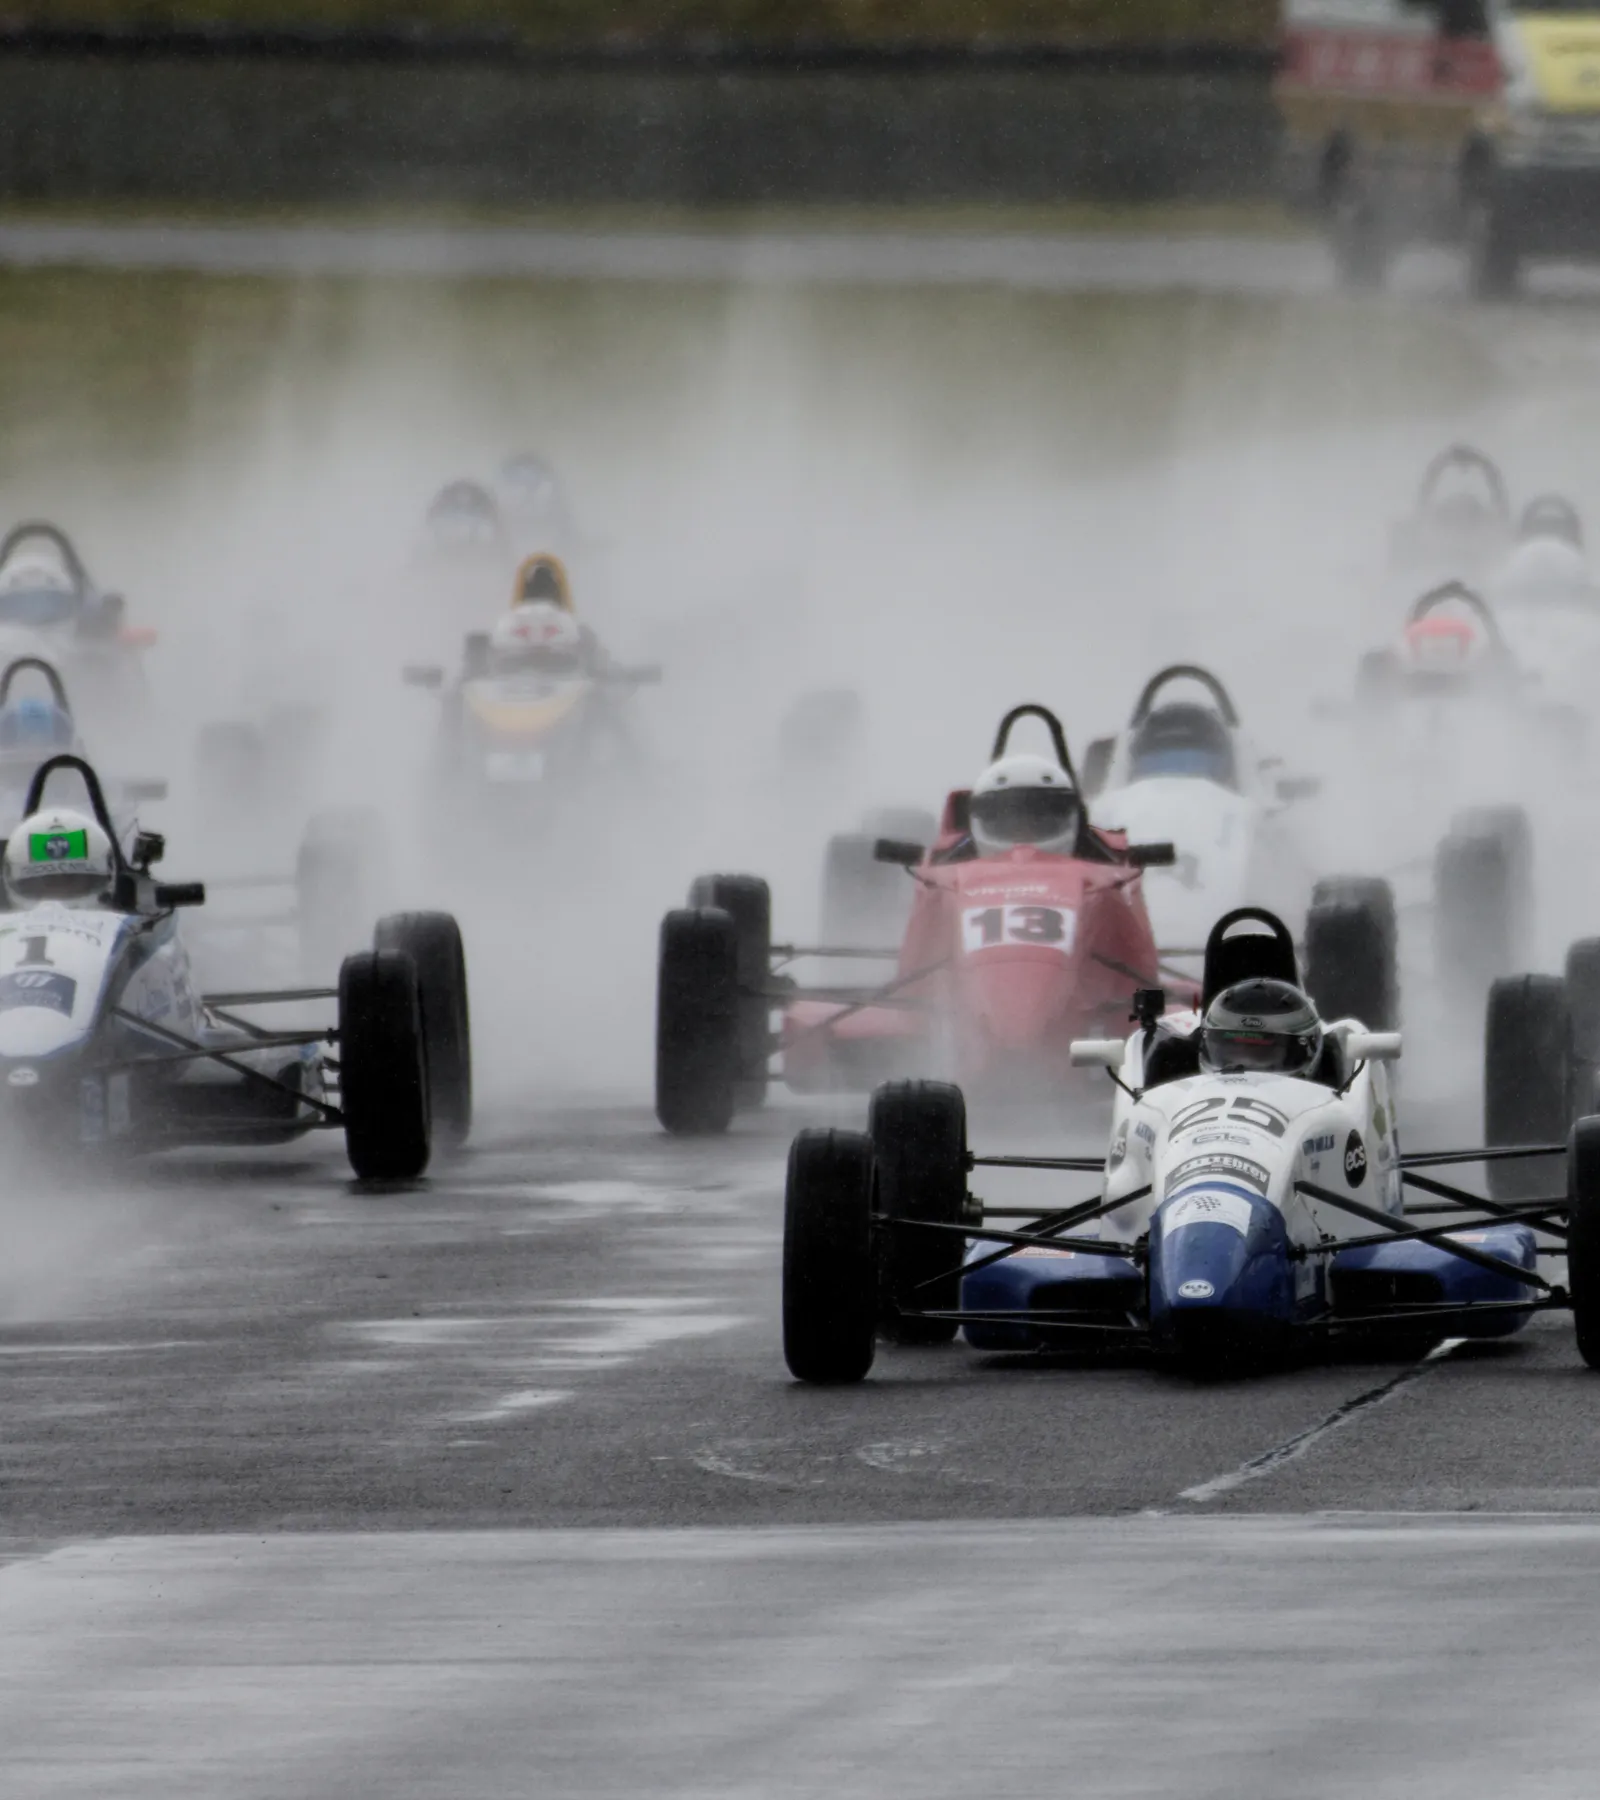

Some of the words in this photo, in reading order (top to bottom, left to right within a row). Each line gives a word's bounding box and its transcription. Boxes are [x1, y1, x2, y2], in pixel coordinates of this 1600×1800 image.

[969, 906, 1064, 946] 13
[15, 935, 55, 967] 1
[1168, 1096, 1290, 1142] 25
[1345, 1145, 1366, 1172] ecs
